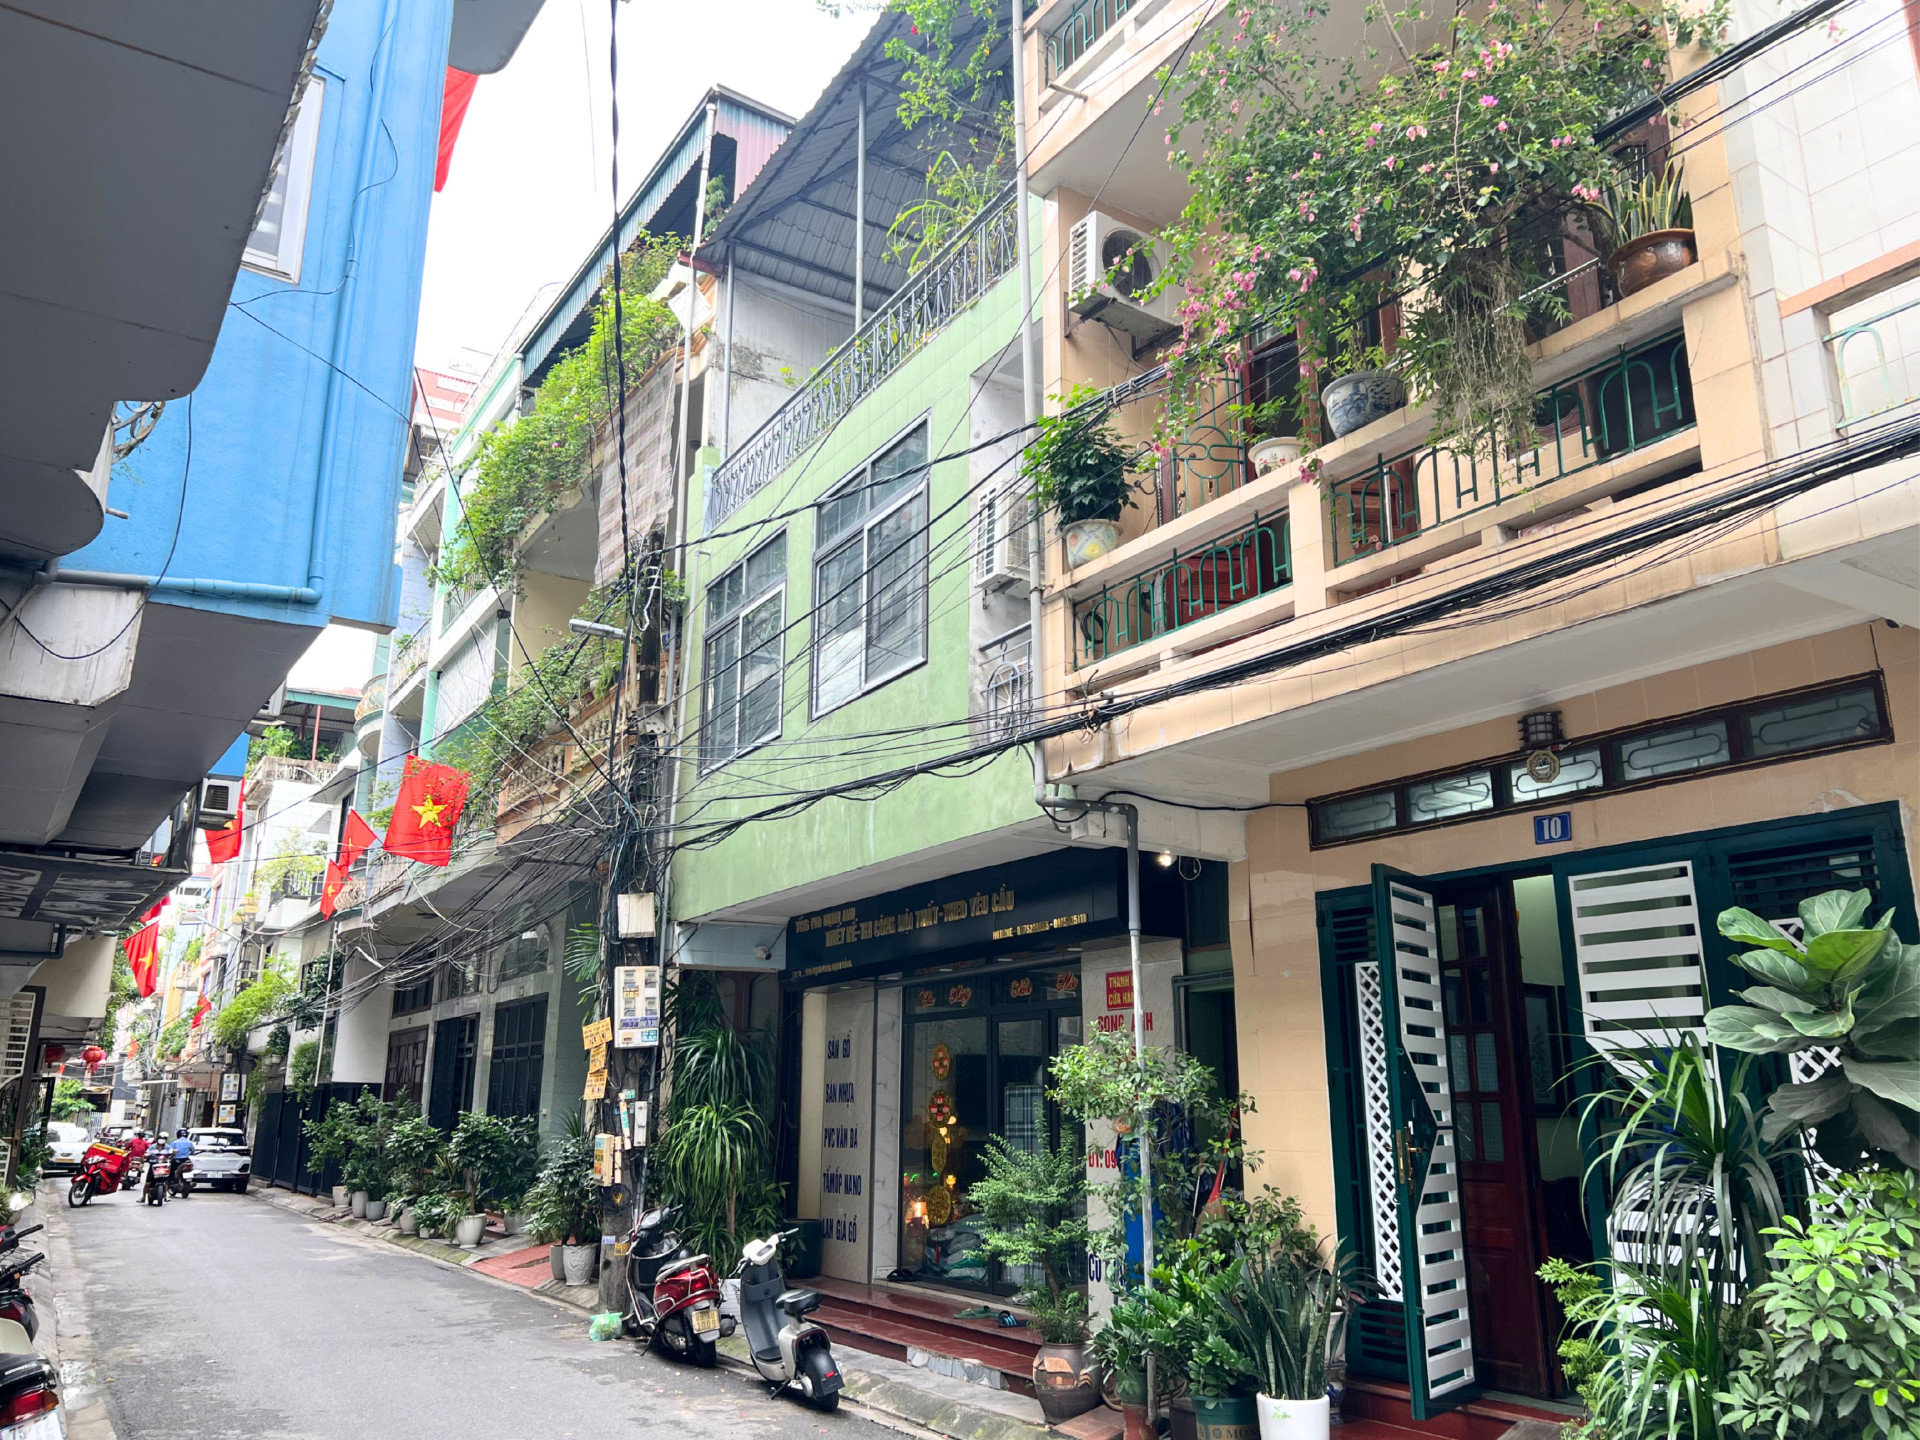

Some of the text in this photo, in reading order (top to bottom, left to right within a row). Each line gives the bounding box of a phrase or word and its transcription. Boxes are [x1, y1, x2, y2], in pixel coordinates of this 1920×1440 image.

[1542, 817, 1562, 840] 10
[1108, 976, 1130, 989] THANH
[844, 1174, 862, 1196] NANO
